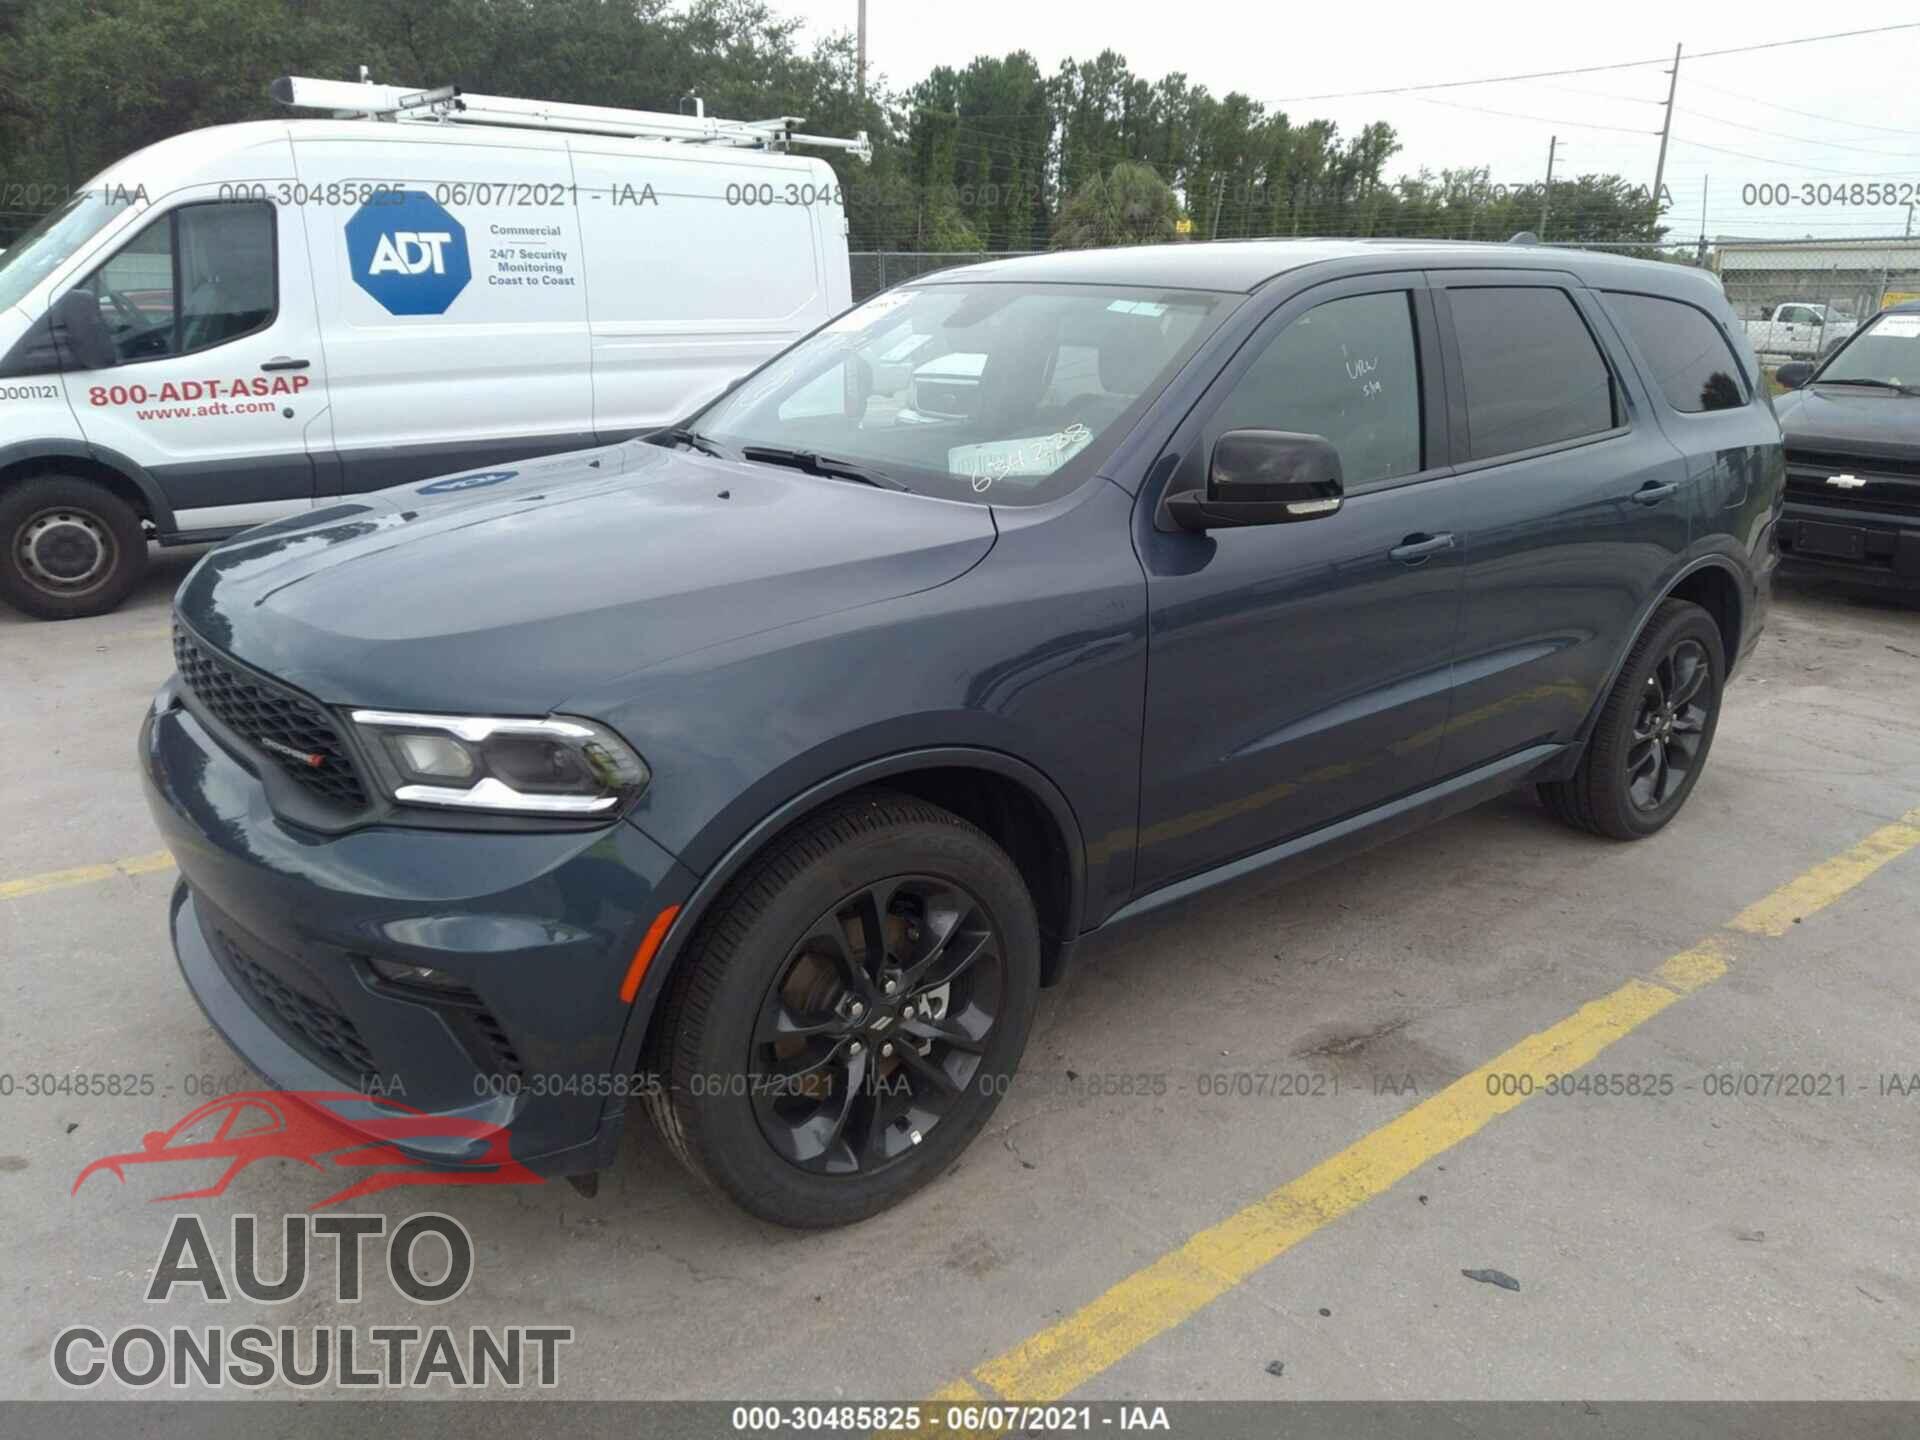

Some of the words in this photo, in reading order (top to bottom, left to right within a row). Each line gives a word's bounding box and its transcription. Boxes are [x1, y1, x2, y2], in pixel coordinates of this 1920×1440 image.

[489, 223, 561, 236] Commercial
[368, 231, 453, 275] ADT
[489, 248, 515, 260] 24/7
[519, 248, 567, 261] Security
[497, 262, 564, 274] Monitoring
[488, 275, 522, 286] Coast
[527, 276, 539, 286] to
[542, 275, 576, 286] Coast
[89, 375, 310, 407] 800-ADT-ASAP
[137, 400, 276, 421] www.adt.com
